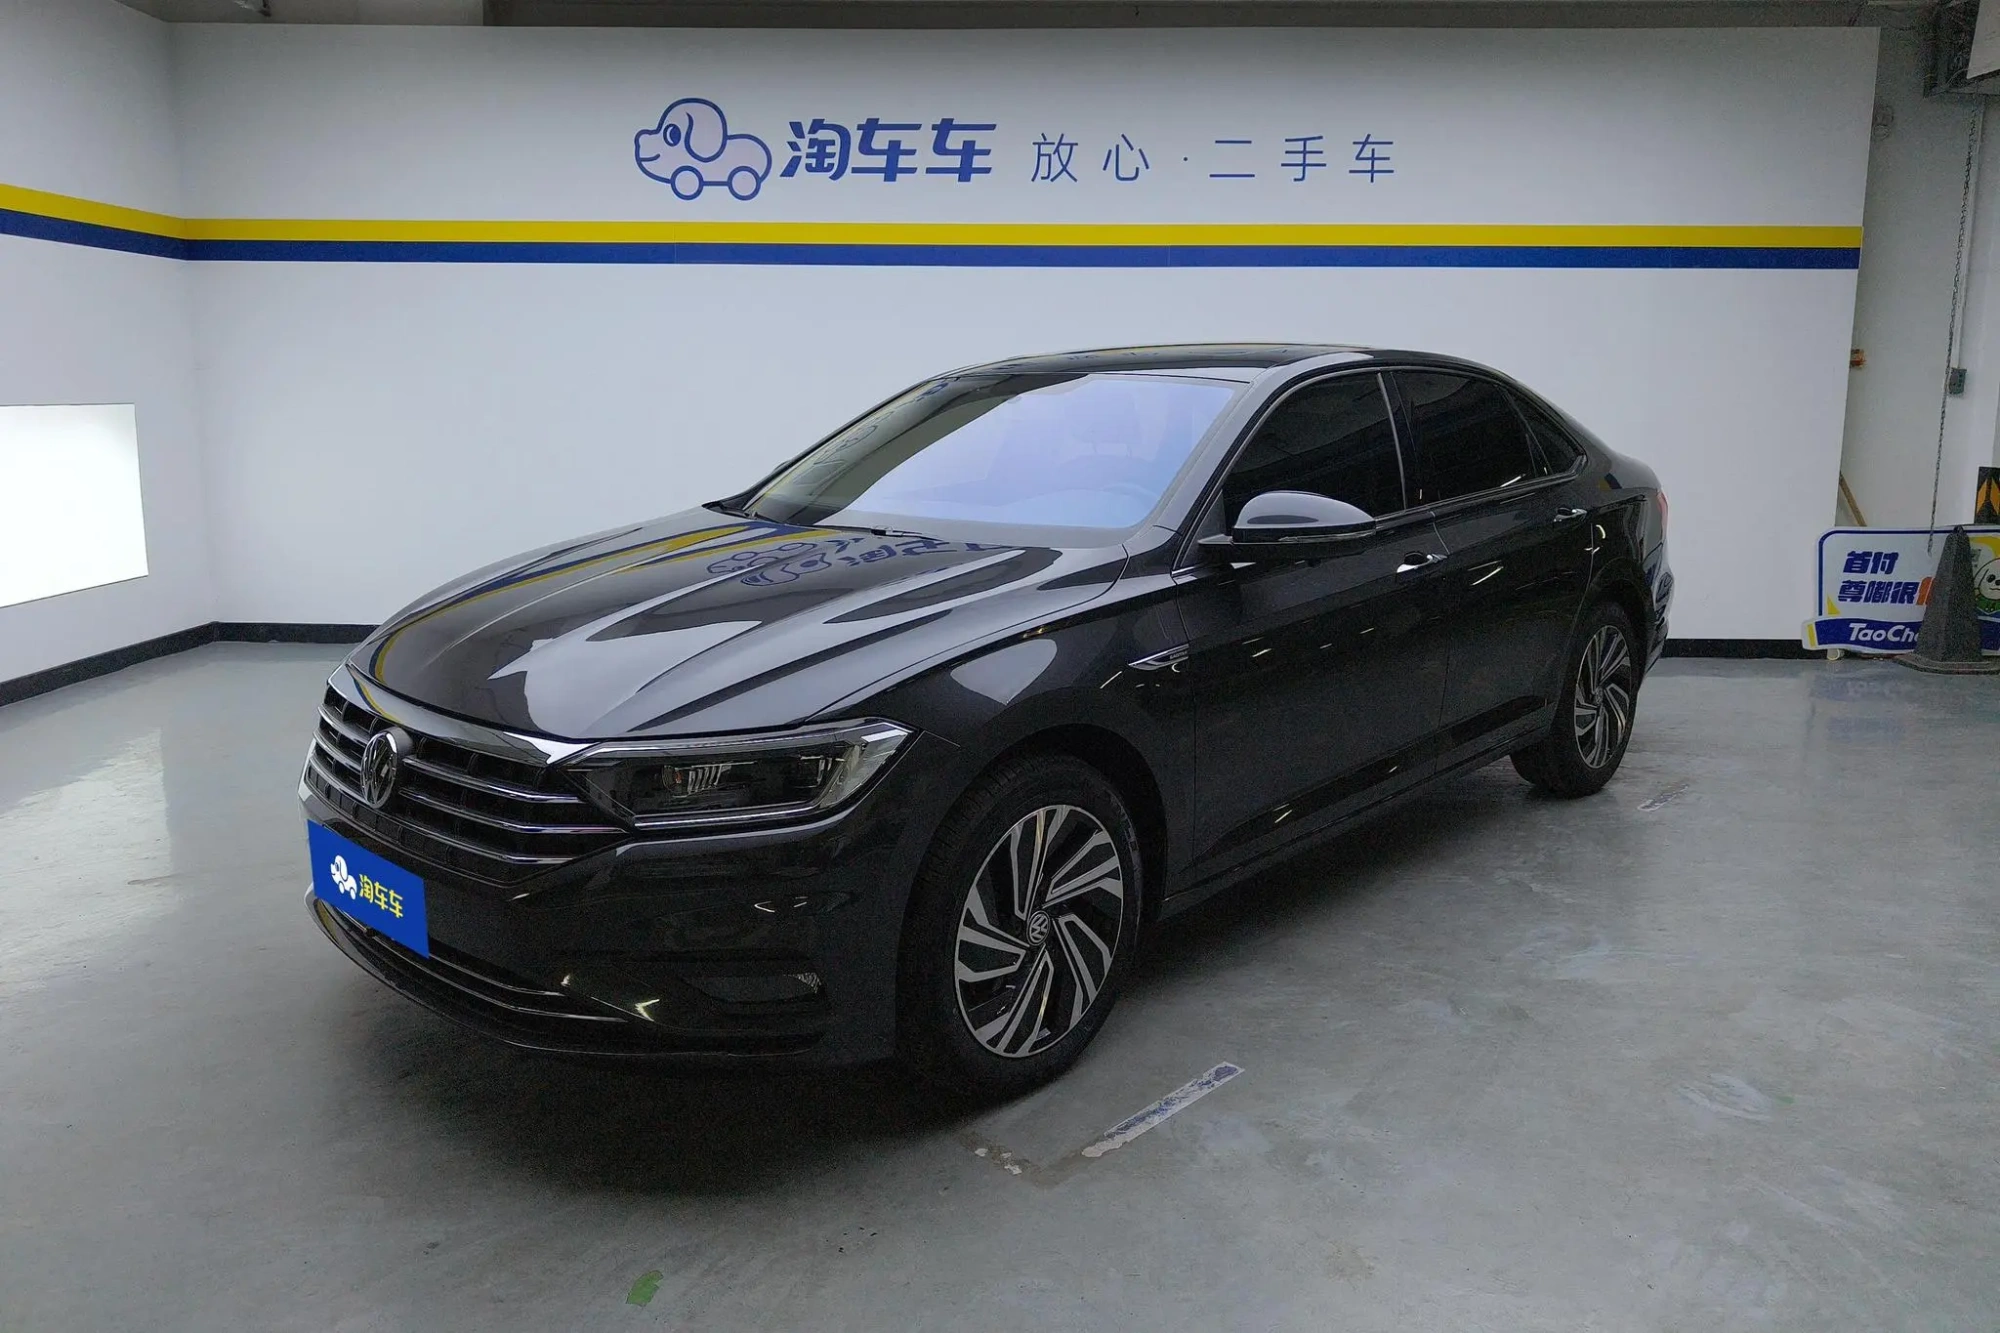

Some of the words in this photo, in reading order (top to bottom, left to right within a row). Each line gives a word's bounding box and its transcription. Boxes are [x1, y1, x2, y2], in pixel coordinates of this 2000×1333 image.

[780, 118, 996, 183] 淘车车
[1843, 551, 1899, 574] 首付
[359, 874, 403, 918] 淘车车
